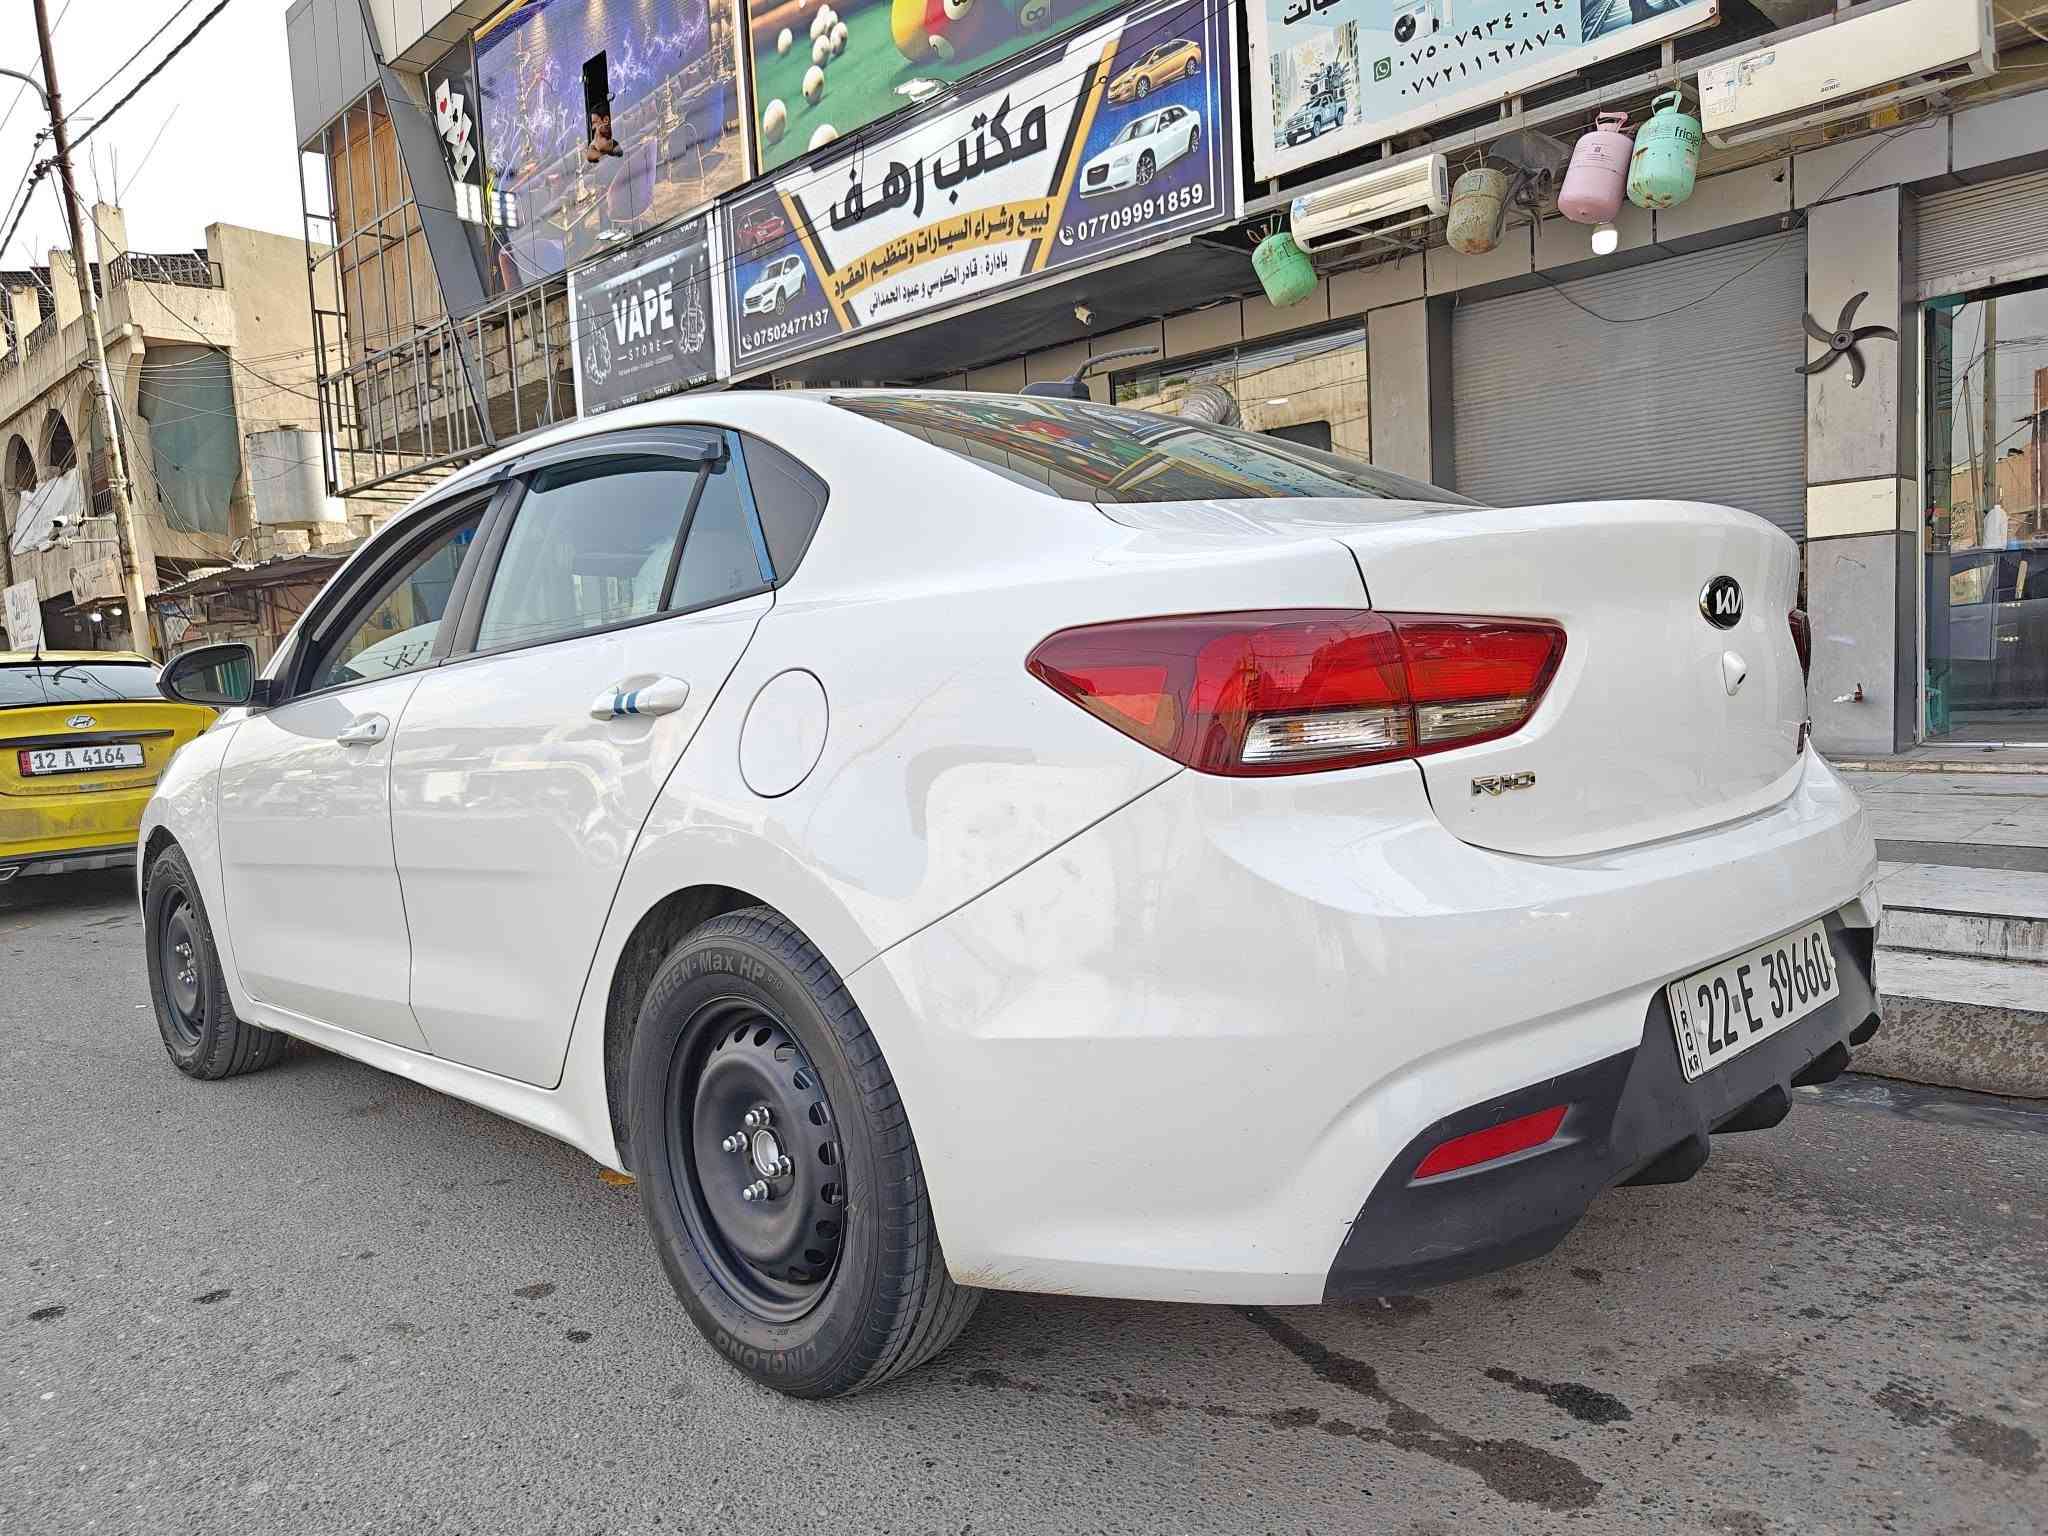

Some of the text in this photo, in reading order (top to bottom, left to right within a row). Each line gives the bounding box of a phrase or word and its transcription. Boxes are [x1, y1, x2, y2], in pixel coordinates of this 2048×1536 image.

[830, 93, 1047, 231] مكتب رهف
[1077, 183, 1203, 241] 07709991859
[834, 202, 1050, 299] لبيع وشراء السيارات وتنظيم العقود
[612, 280, 674, 346] VAPE
[753, 308, 829, 347] 07502477137
[628, 339, 661, 361] STORE
[33, 752, 57, 770] 12
[65, 751, 75, 768] A
[82, 747, 126, 766] 4164
[1471, 771, 1536, 797] RIO
[1760, 932, 1831, 1018] 39660
[1687, 1054, 1700, 1073] KR
